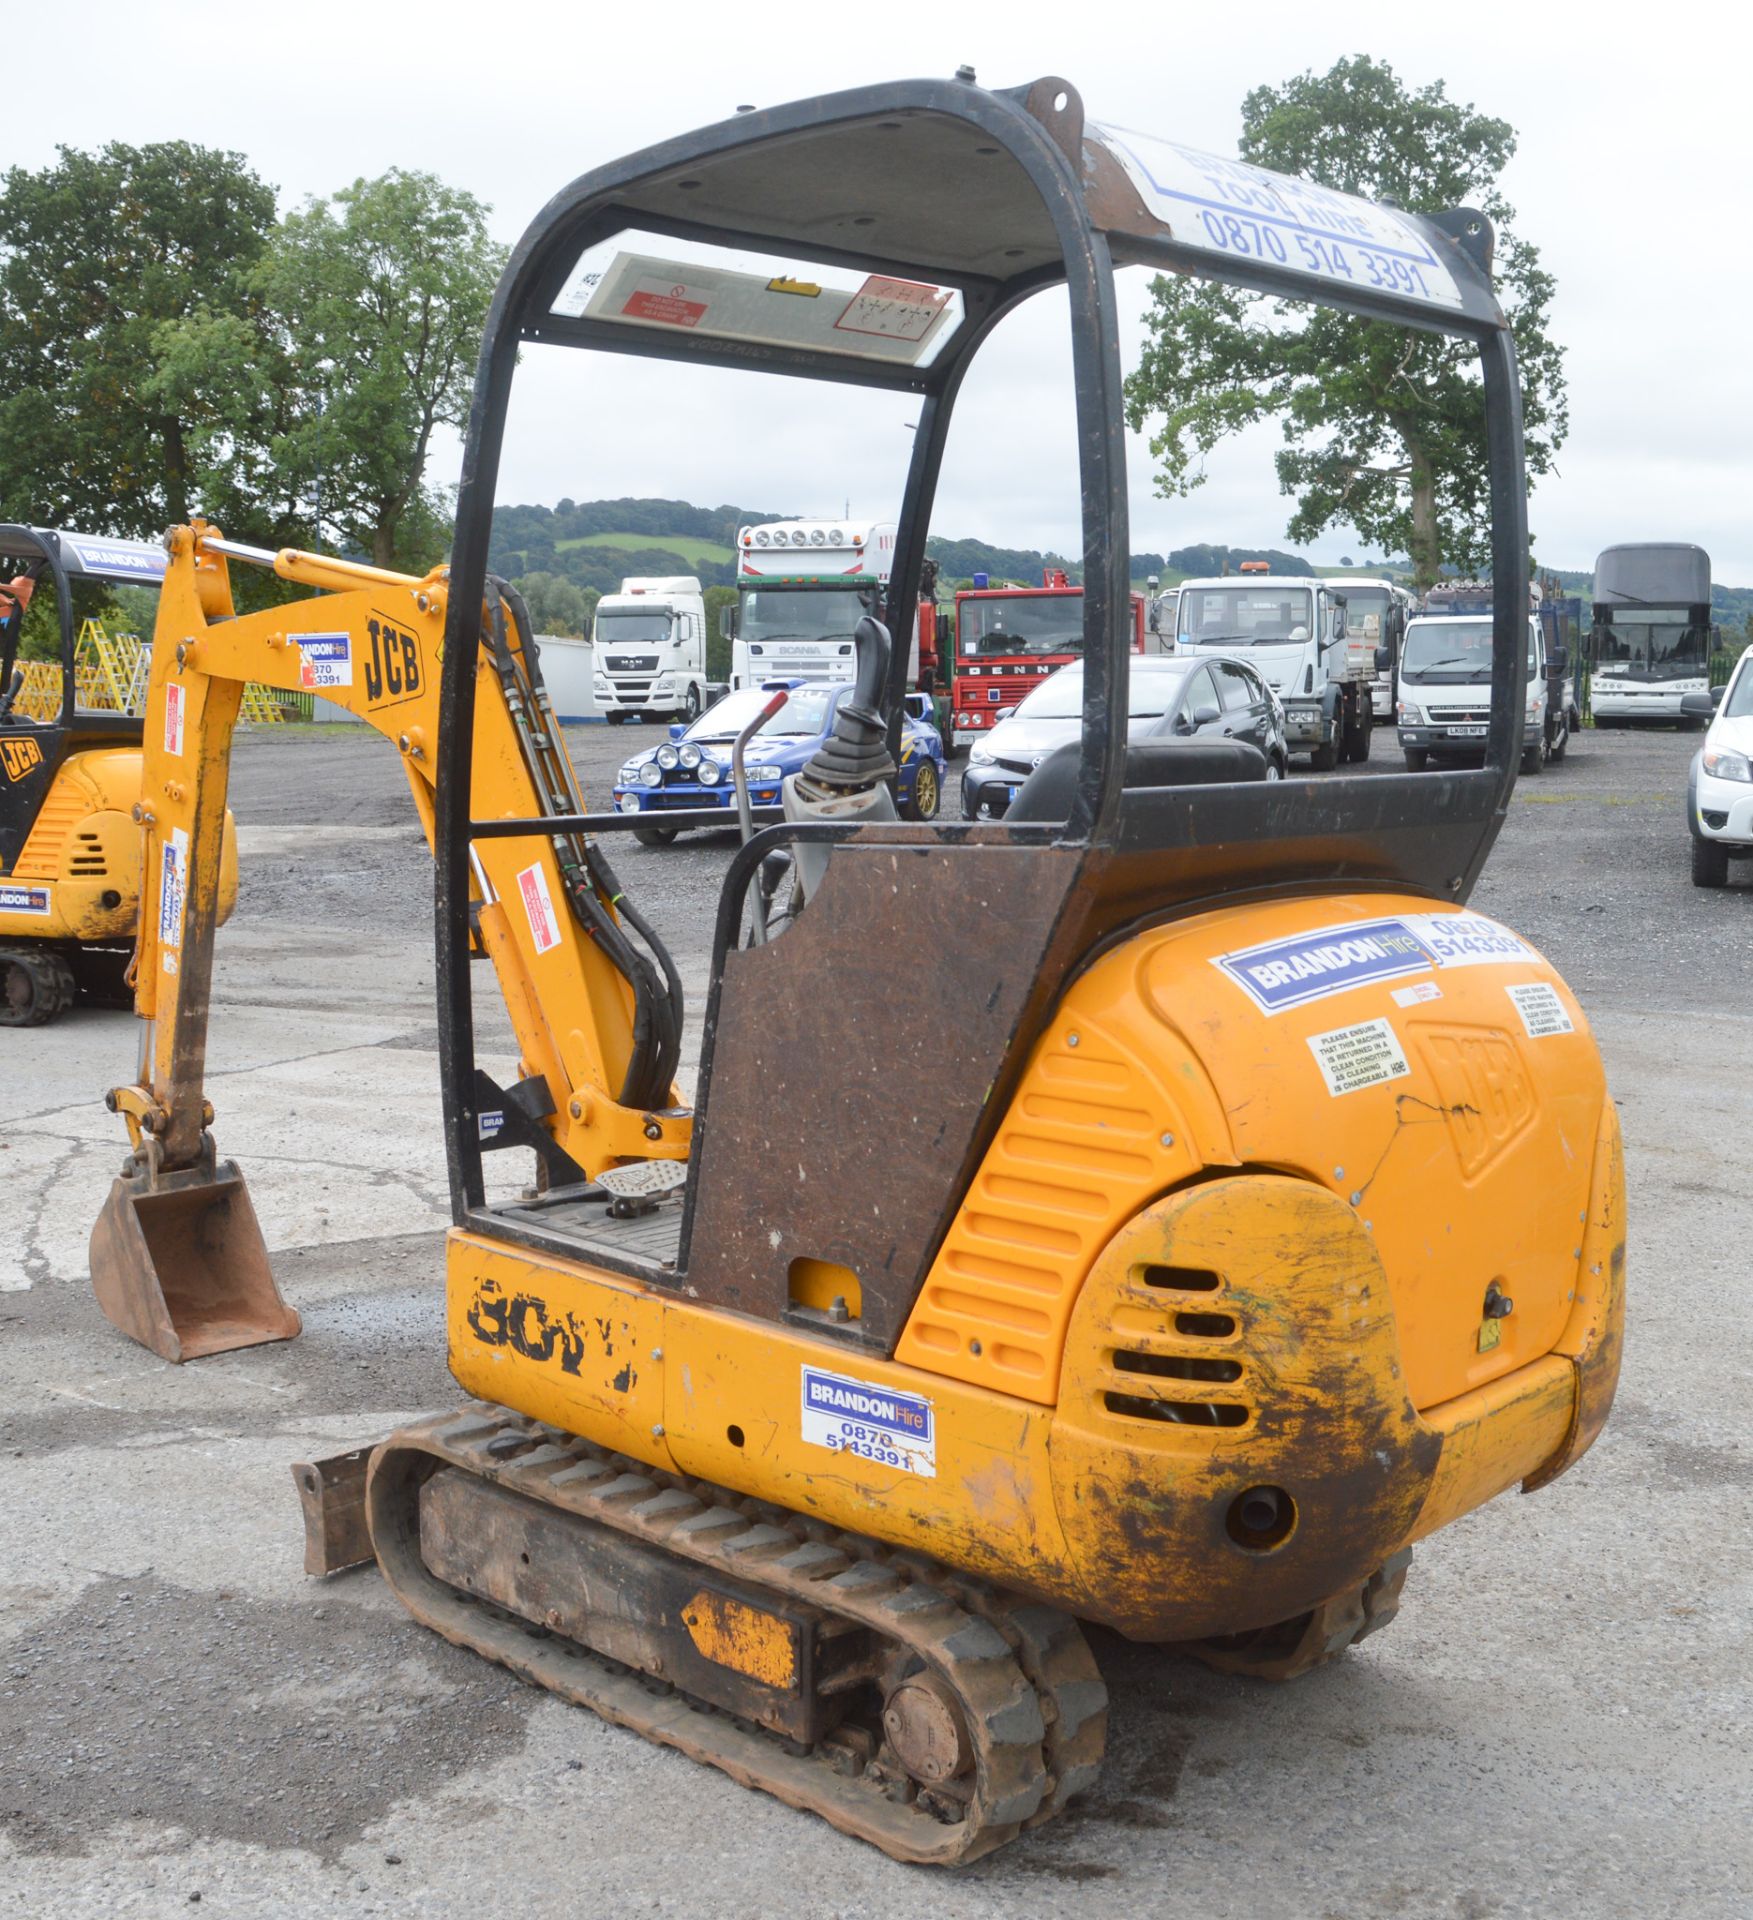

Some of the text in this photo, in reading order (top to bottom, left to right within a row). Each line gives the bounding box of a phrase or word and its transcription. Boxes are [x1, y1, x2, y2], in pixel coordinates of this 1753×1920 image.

[1204, 175, 1376, 239] TOOL HIRE
[1201, 208, 1431, 299] 0870 514 3391
[364, 618, 419, 701] JCB
[779, 646, 821, 655] SCANIA
[969, 665, 1065, 675] DENN
[4, 741, 39, 776] JCB
[1431, 920, 1497, 936] 0870
[1319, 1031, 1387, 1056] THAT THIS MACHINE
[1321, 1025, 1376, 1045] PLEASE ENSURE
[1327, 1055, 1335, 1064] IS
[1336, 1045, 1373, 1060] RETURNED
[1373, 1043, 1382, 1051] IN
[1330, 1049, 1392, 1073] CLEAN CONDITION
[1333, 1084, 1342, 1092] IS
[1343, 1071, 1388, 1090] CHARGEABLE
[1335, 1063, 1381, 1082] AS CLEANING
[841, 1423, 893, 1448] 0870
[826, 1433, 910, 1470] 5143391
